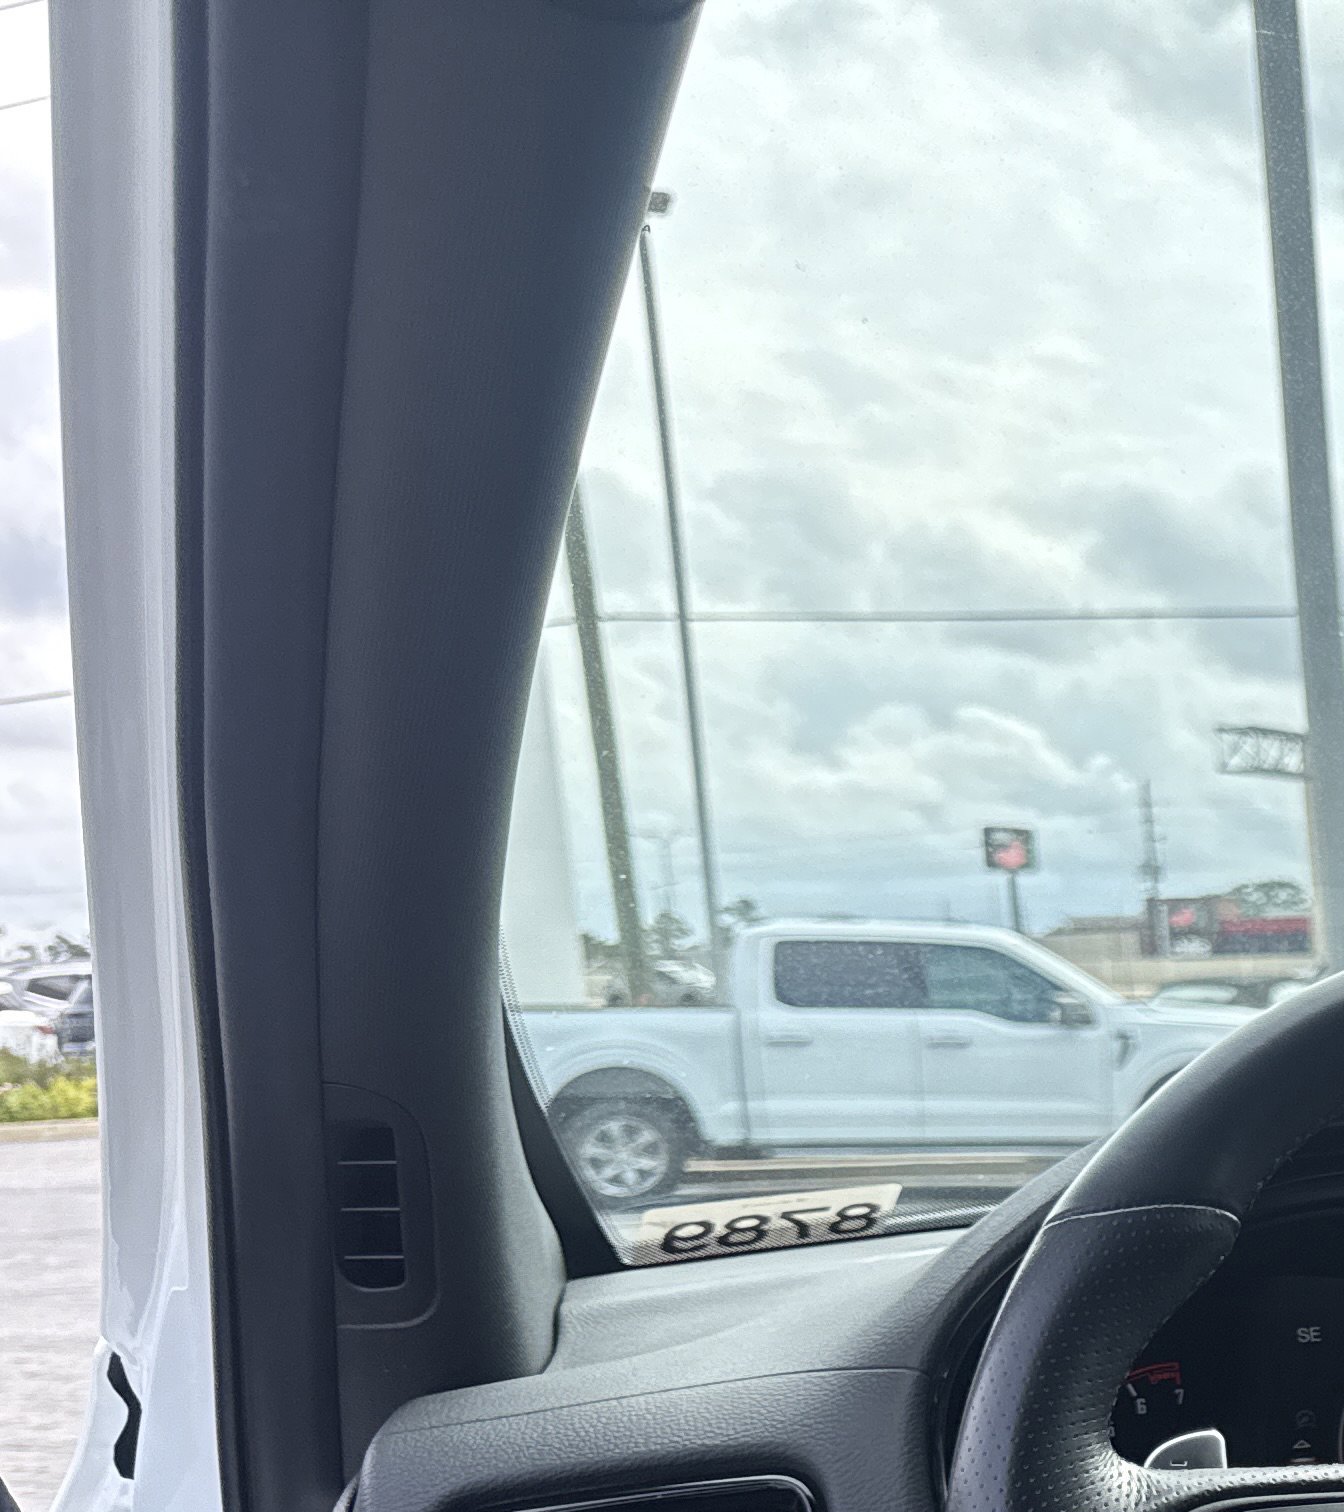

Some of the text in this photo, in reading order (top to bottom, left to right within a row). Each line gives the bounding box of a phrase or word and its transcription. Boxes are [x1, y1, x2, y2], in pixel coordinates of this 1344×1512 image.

[1297, 1327, 1322, 1343] SE
[1173, 1388, 1185, 1405] 7
[1136, 1397, 1148, 1415] 6
